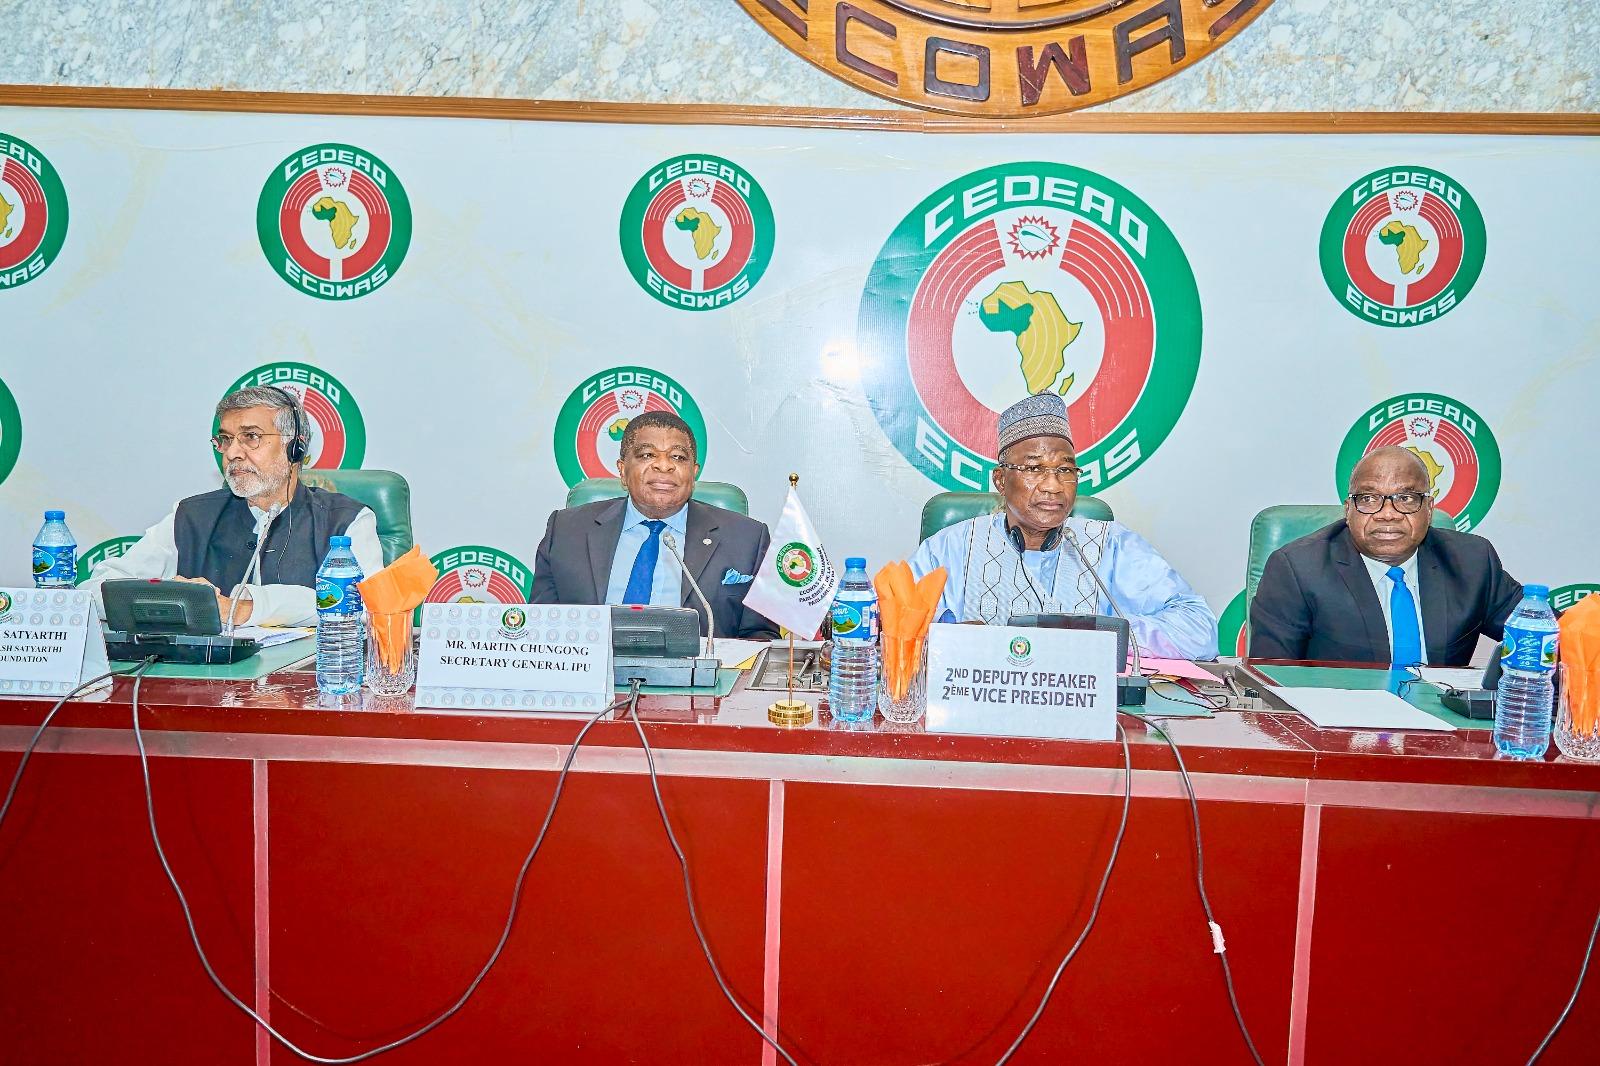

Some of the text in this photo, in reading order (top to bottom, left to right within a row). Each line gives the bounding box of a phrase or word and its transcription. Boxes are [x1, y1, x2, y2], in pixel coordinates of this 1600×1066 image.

[284, 148, 388, 188] CEDEAO
[649, 158, 751, 198] CEDEAO
[1352, 171, 1462, 210] CEDEAO
[924, 174, 1149, 260] CEDEAO
[285, 257, 389, 298] ECOWAS
[646, 268, 751, 309] ECOWAS
[1346, 284, 1457, 325] ECOWAS
[582, 371, 684, 410] CEDEAO
[1368, 398, 1477, 438] CEDEAO
[914, 415, 1142, 494] ECAS
[432, 551, 526, 588] EDEAO
[3, 630, 68, 641] SATYARTHI
[14, 645, 62, 653] SATYARTHI
[445, 639, 590, 656] MR. MARTIN CHUNGONG
[440, 655, 592, 672] SECRETARY GENERAL IPU
[945, 667, 1098, 690] 2ND DEPUTY SPEAKER
[942, 684, 1098, 708] 2ÈME VICE PRESIDENT
